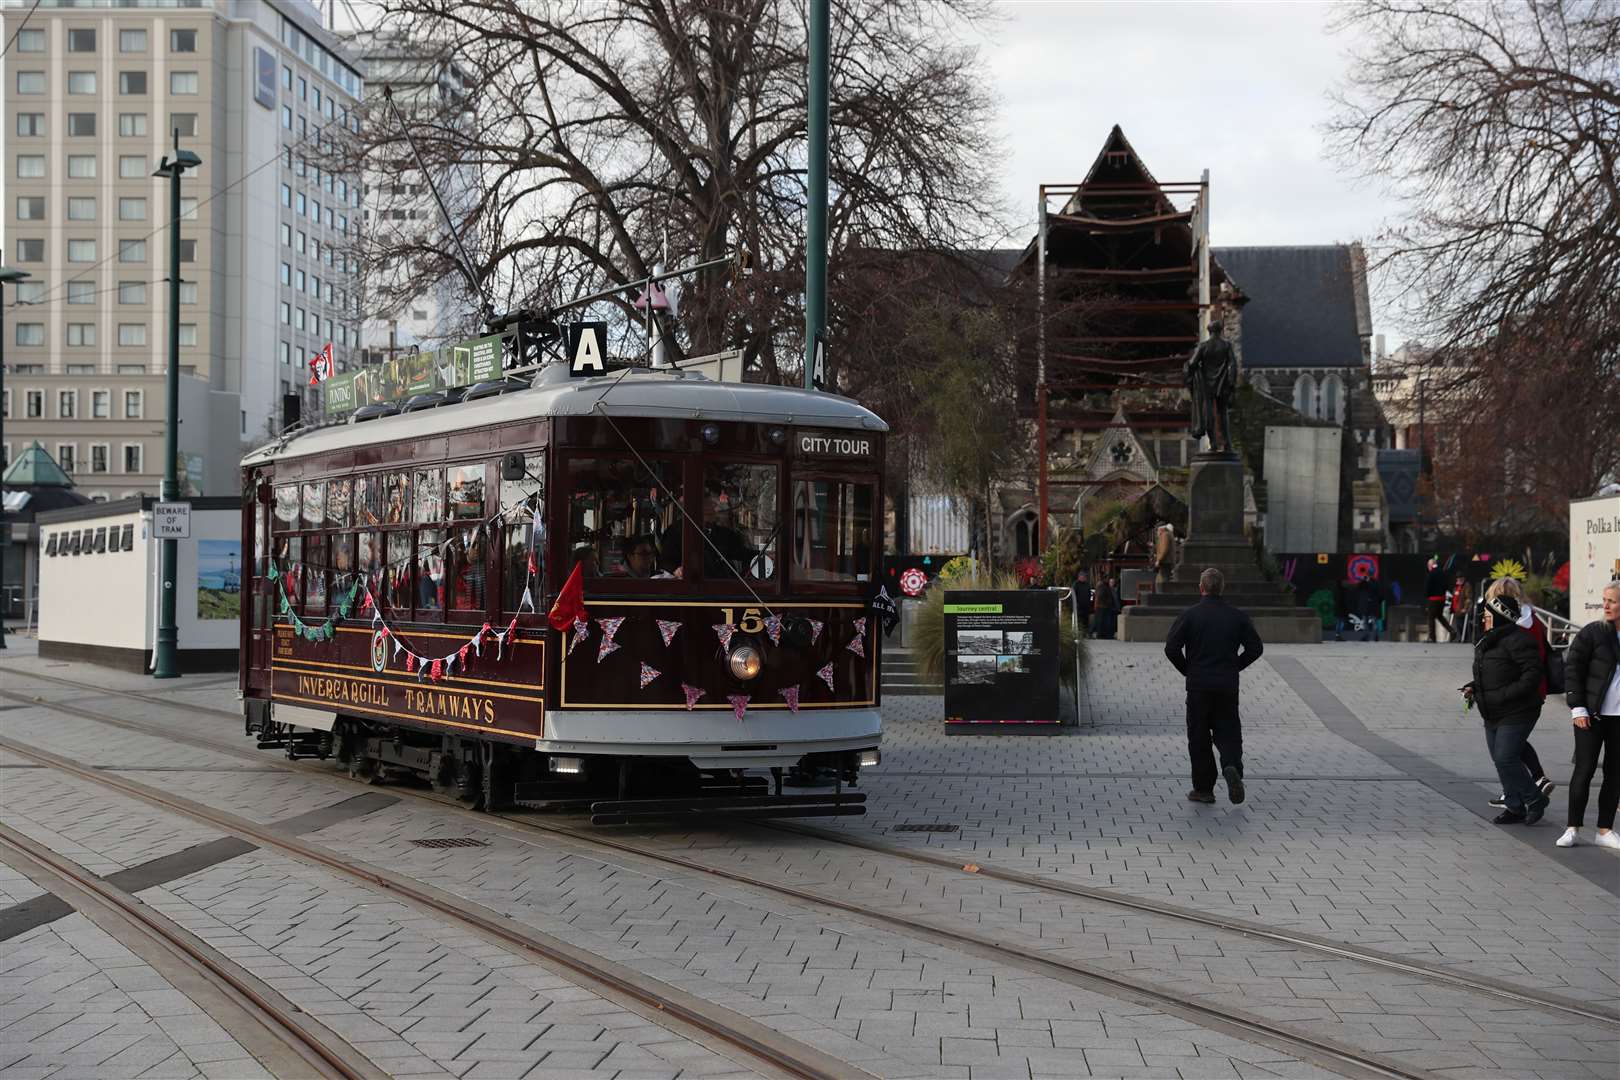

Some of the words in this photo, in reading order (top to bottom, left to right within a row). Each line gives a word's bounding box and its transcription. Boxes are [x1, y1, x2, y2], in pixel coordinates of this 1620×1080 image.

[573, 328, 604, 371] A
[813, 341, 824, 384] A
[801, 437, 831, 453] CITY
[834, 439, 870, 455] TOUR
[156, 507, 188, 515] BEWARE
[166, 516, 177, 524] OF
[160, 525, 182, 534] TRAM
[1586, 517, 1612, 535] Polka
[720, 608, 765, 633] 15
[299, 674, 390, 707] INVERCARGILL
[405, 689, 495, 724] TRAMWAYS
